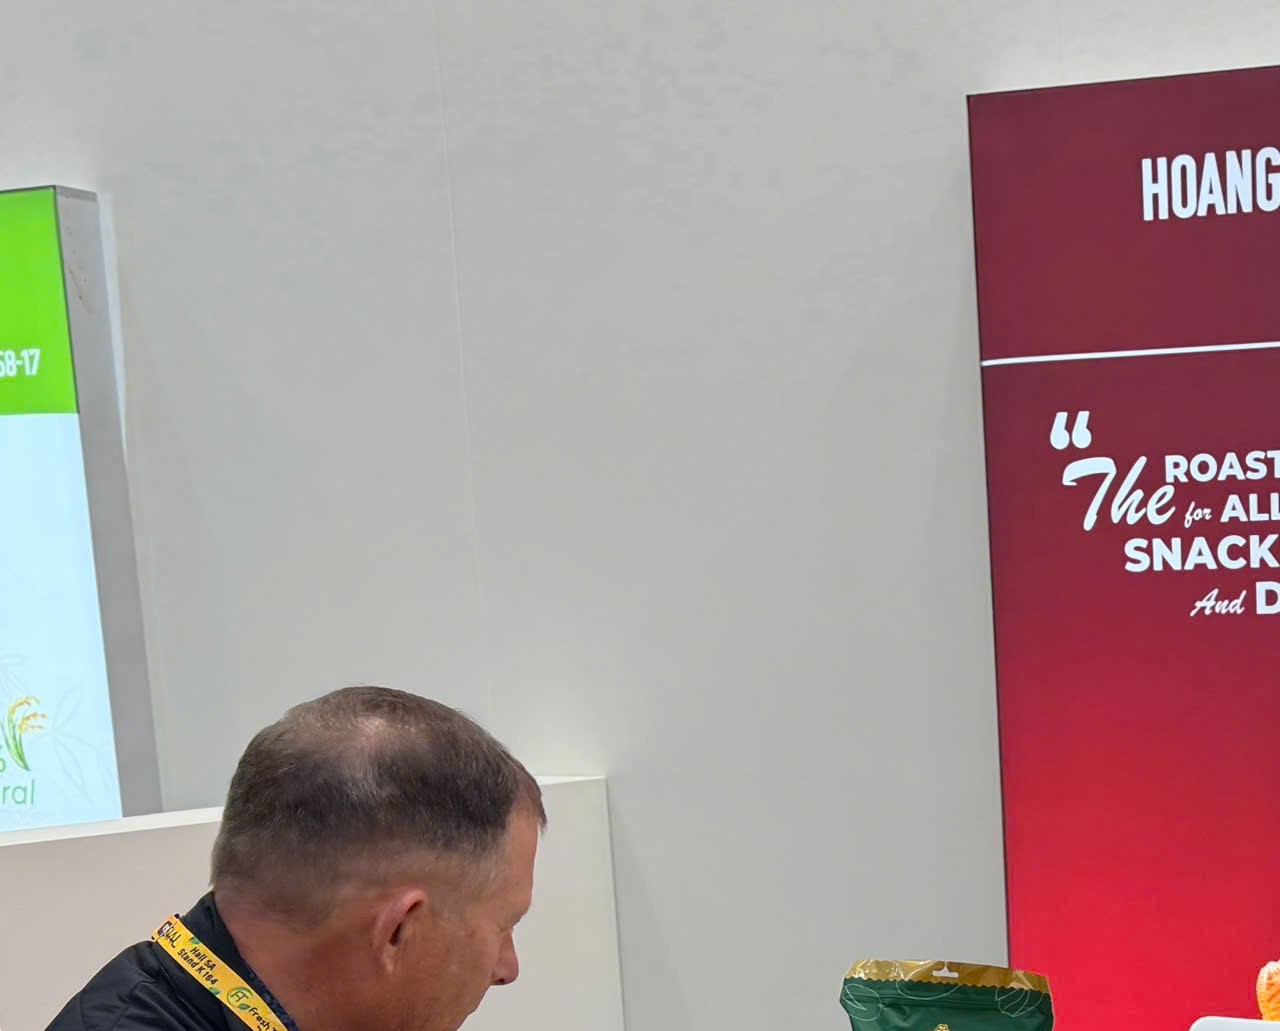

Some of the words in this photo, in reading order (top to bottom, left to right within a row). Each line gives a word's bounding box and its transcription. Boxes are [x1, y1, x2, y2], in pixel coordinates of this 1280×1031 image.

[1062, 455, 1177, 532] The
[1183, 500, 1213, 529] for
[1189, 587, 1247, 617] And
[177, 948, 200, 968] Stand
[195, 965, 206, 975] K
[189, 946, 208, 962] Hall
